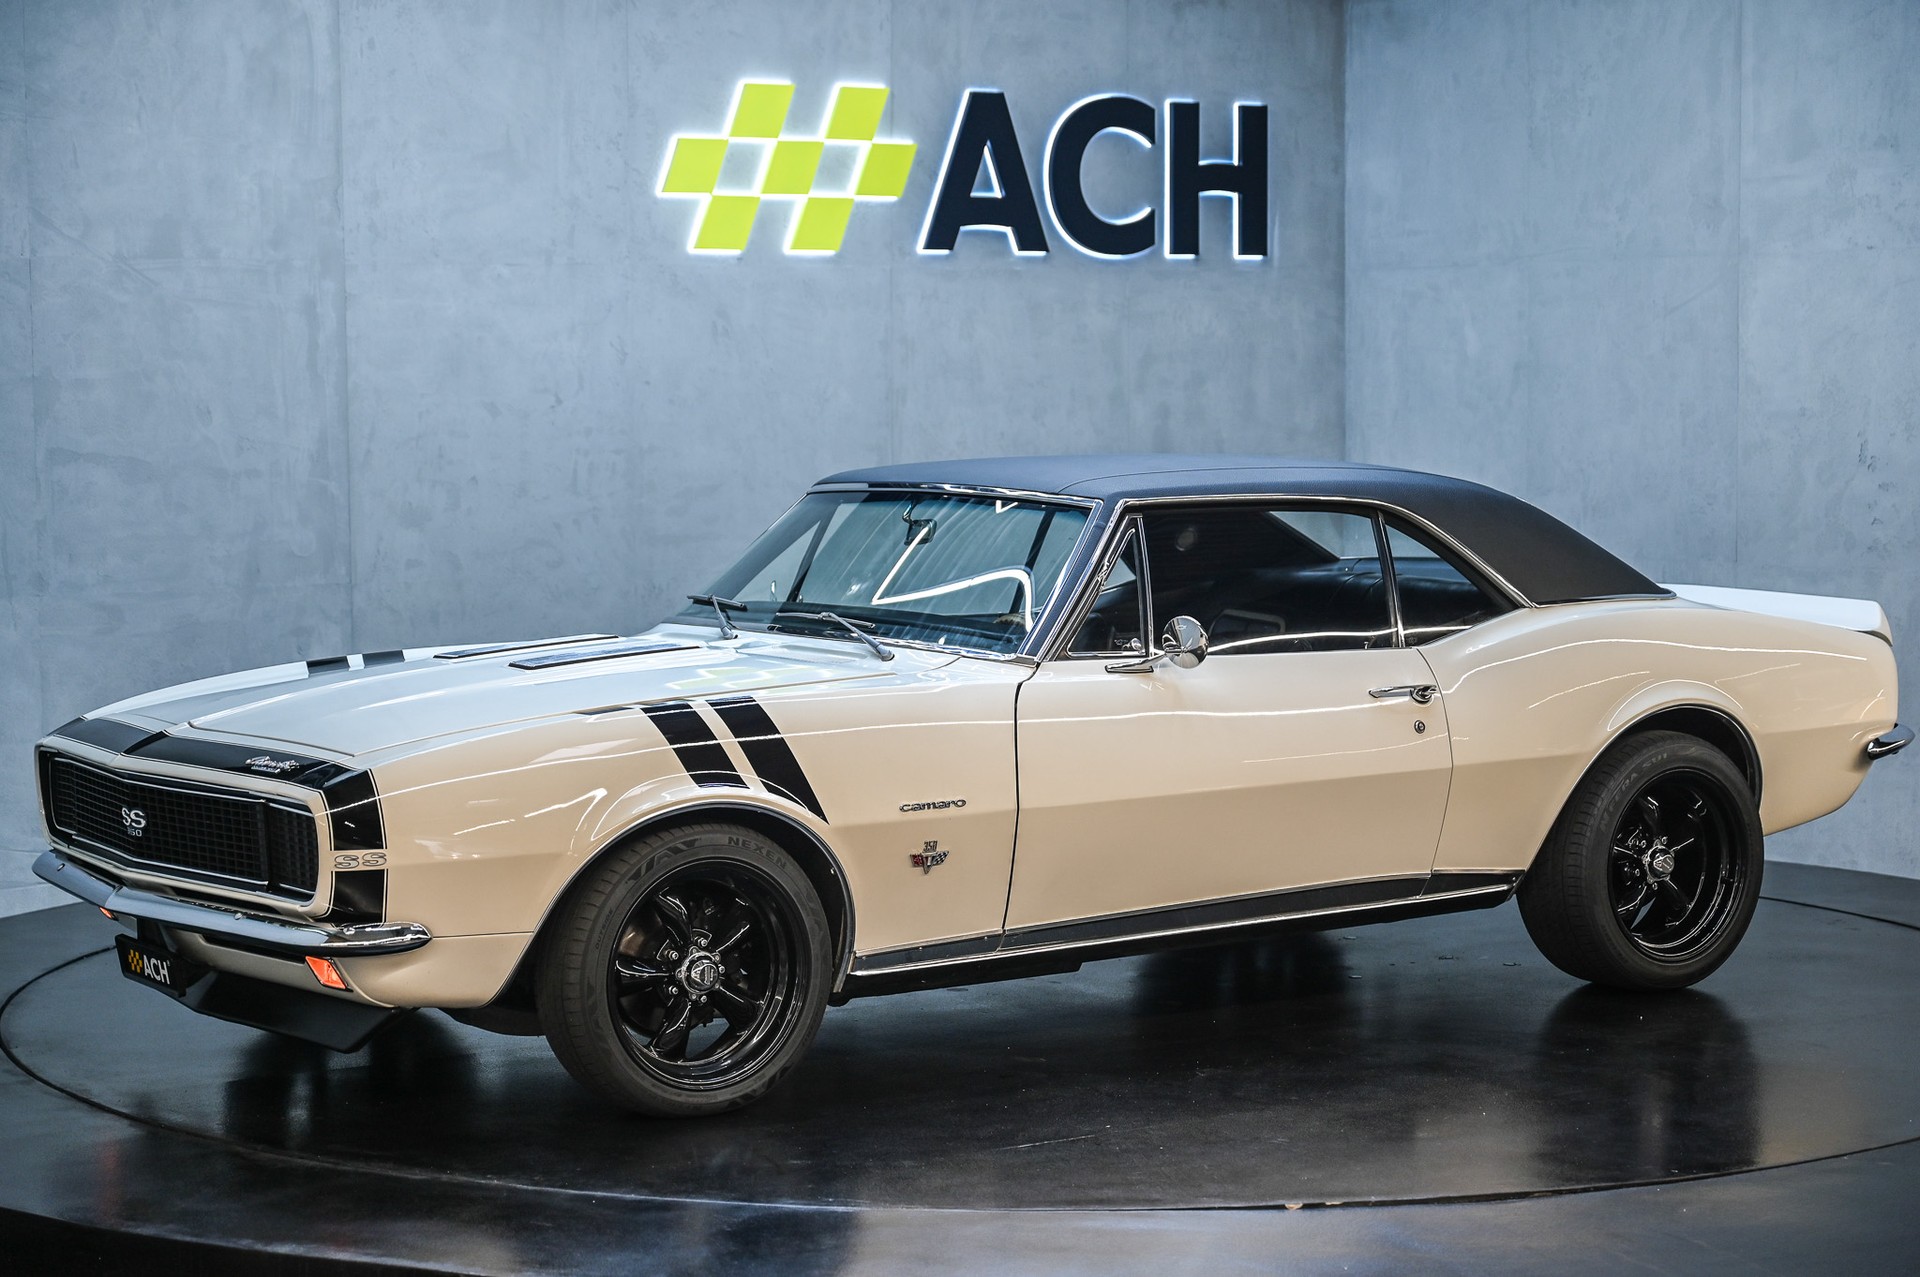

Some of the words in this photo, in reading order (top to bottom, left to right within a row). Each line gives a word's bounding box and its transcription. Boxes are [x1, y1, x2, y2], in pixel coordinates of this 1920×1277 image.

[916, 88, 1269, 260] ACH
[121, 807, 147, 828] SS
[899, 799, 967, 812] camaro
[334, 852, 387, 869] SS
[727, 836, 788, 869] NEXEN
[143, 954, 171, 985] ACH
